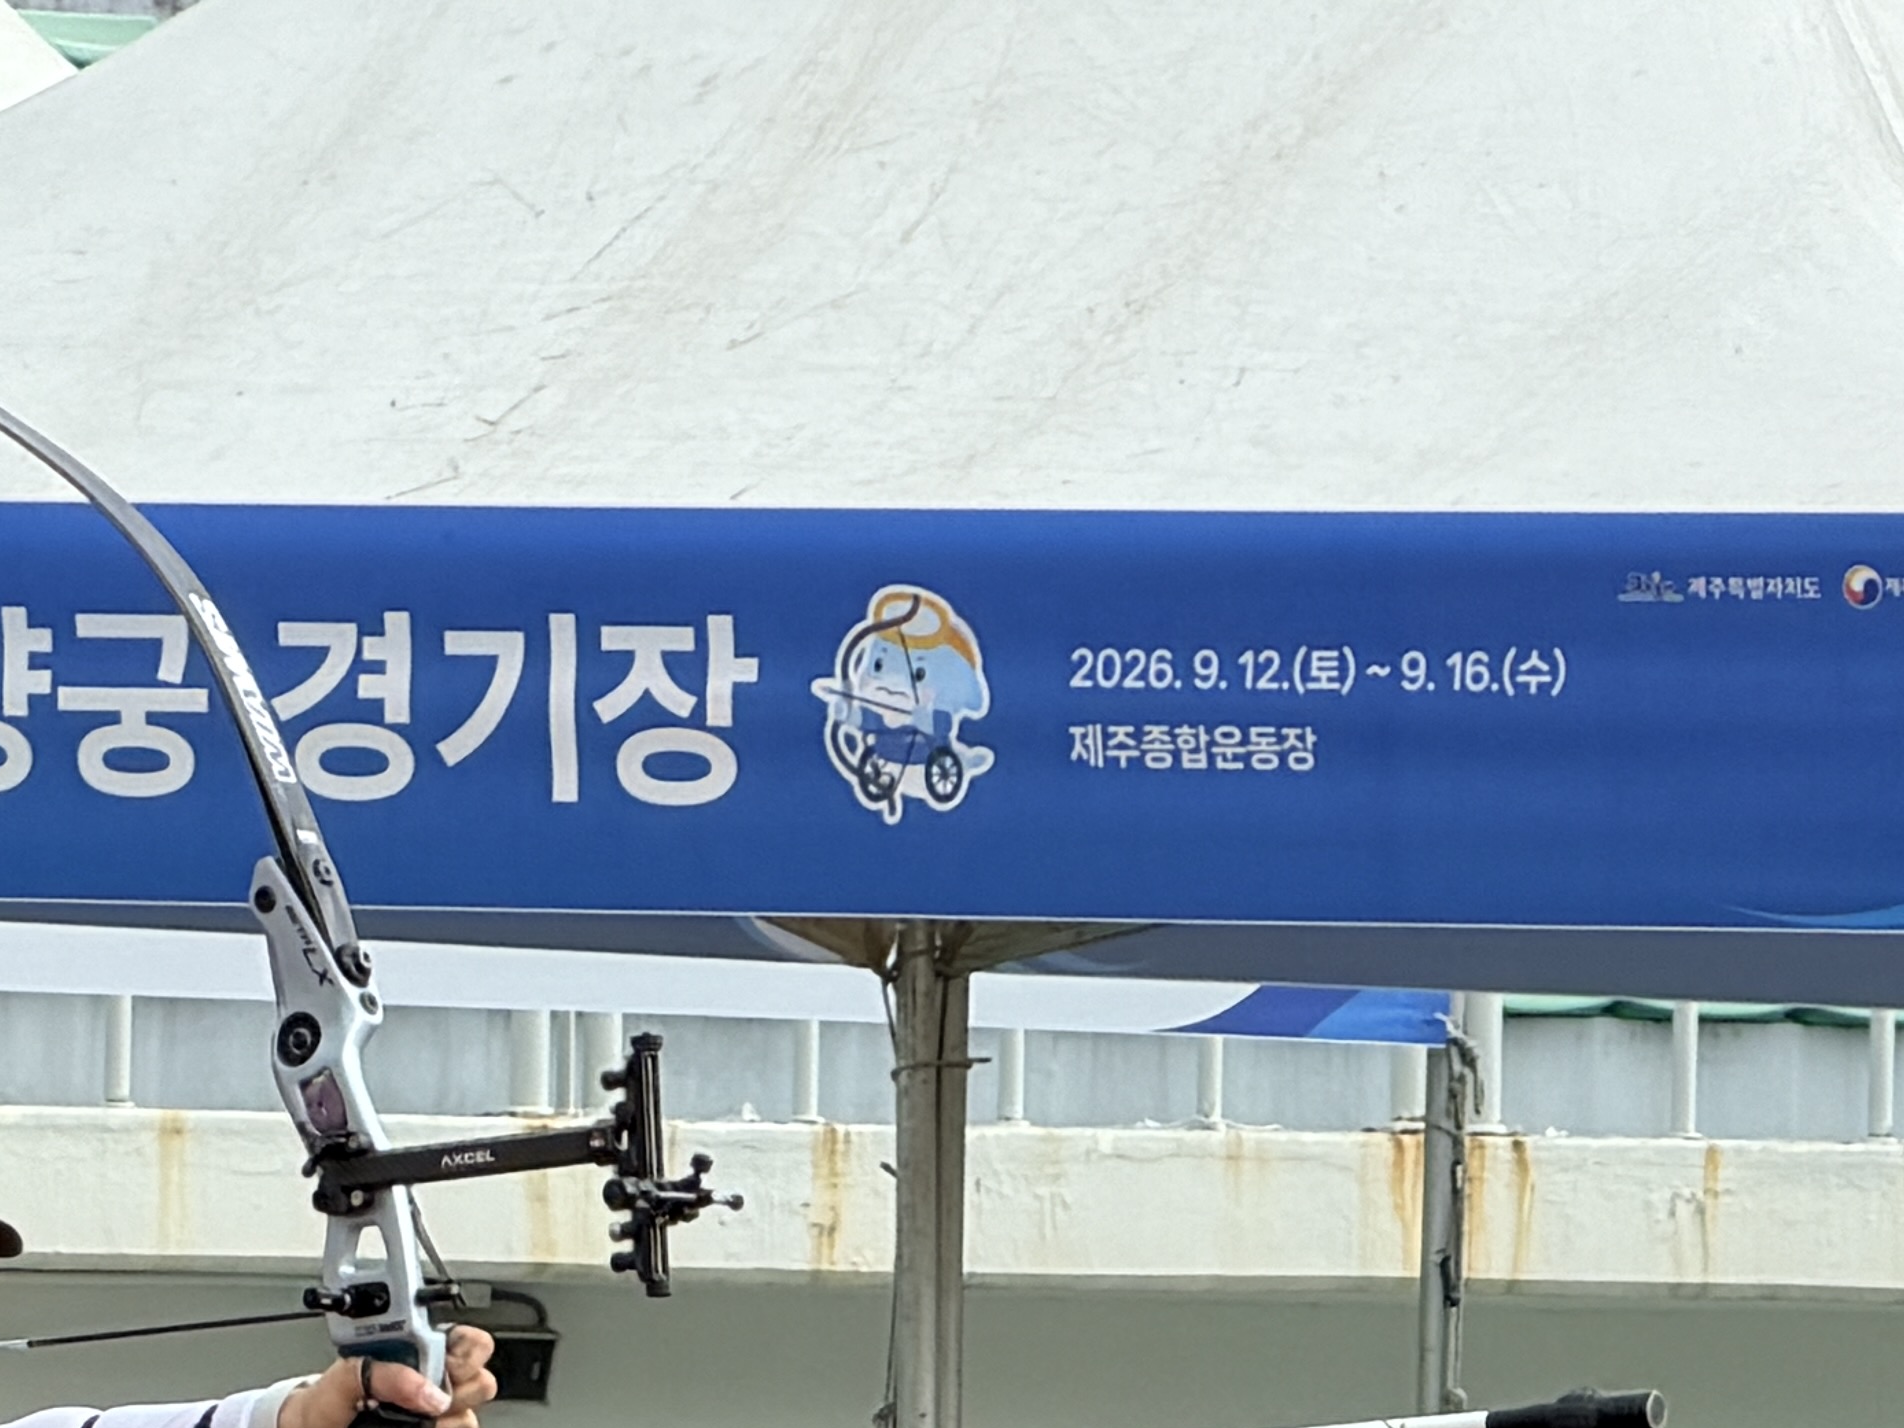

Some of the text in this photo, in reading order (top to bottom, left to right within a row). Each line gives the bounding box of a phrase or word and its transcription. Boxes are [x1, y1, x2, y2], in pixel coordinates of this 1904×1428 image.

[1687, 575, 1822, 600] 제주특별자치도
[1068, 647, 1183, 690] 2026.
[1193, 648, 1228, 691] 9.
[1237, 645, 1356, 696] 12.(토)
[1400, 649, 1436, 691] 9.
[1446, 646, 1567, 697] 16.(수)
[270, 610, 760, 807] 경기장
[1067, 723, 1318, 771] 제주종합운동장
[441, 1149, 496, 1169] AXCEL
